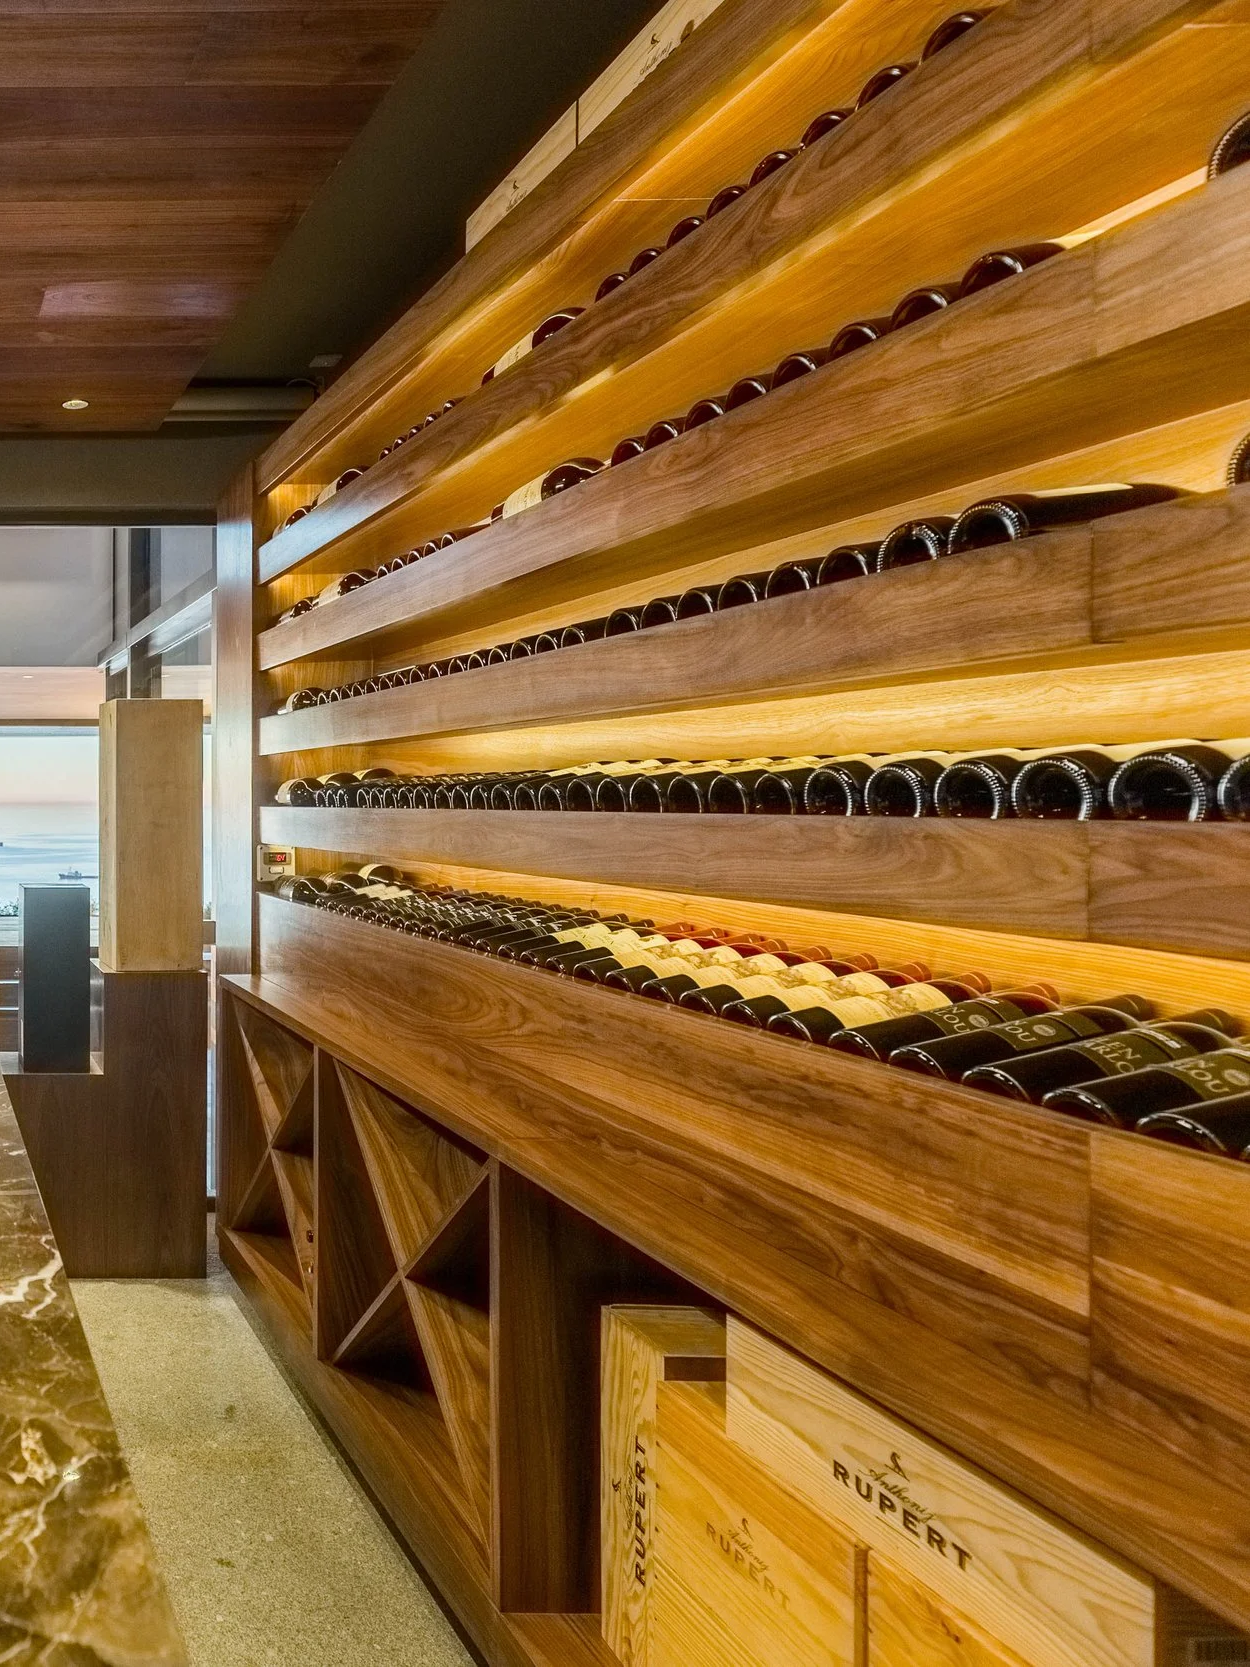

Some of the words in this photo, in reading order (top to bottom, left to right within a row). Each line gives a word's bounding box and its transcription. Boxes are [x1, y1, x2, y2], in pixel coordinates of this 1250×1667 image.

[635, 1435, 646, 1588] RUPERT
[706, 1521, 790, 1611] RUPERT
[833, 1459, 973, 1572] RUPERT
